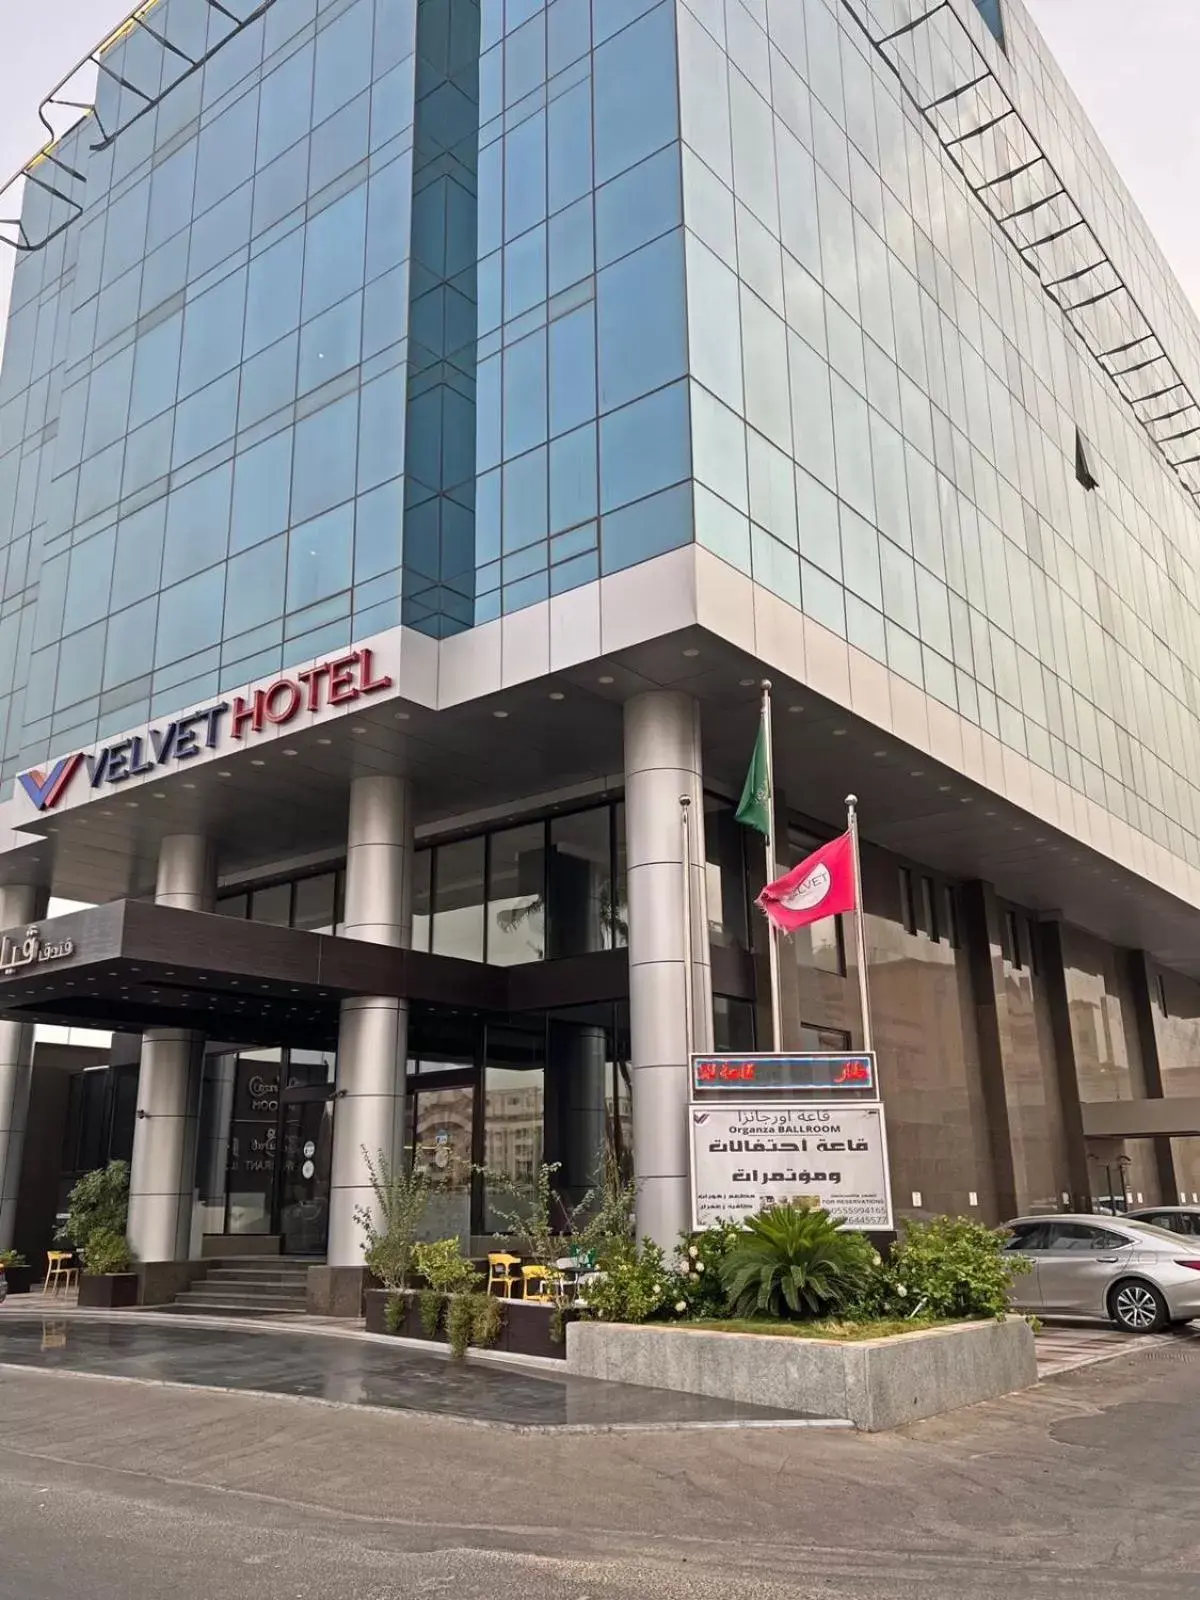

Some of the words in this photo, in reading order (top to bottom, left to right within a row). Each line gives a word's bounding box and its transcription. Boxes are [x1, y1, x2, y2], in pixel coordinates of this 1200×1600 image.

[85, 700, 229, 788] VELVET
[230, 648, 393, 739] HOTEL
[729, 1125, 775, 1135] Organza
[778, 1125, 841, 1134] BALLROOM
[709, 1139, 808, 1153] احتفالات
[816, 1138, 869, 1152] قاعة
[732, 1168, 842, 1184] ومؤتمرات
